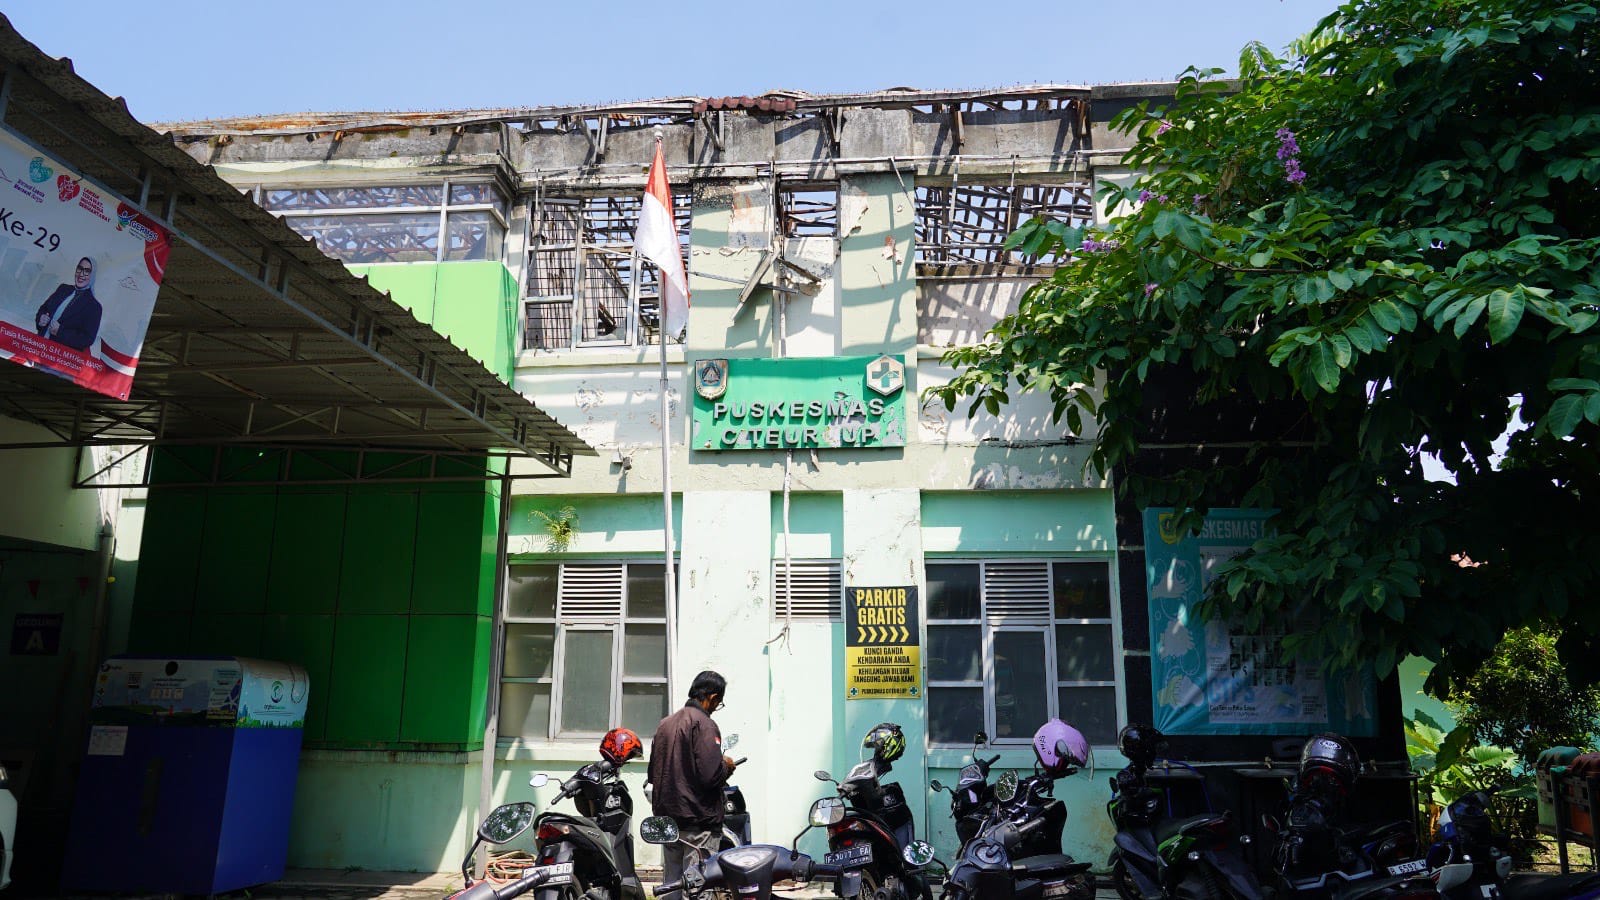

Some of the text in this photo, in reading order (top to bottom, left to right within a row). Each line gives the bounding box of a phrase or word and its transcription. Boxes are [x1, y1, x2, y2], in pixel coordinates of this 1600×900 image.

[0, 207, 61, 252] Ke-29
[131, 221, 159, 241] GERMAS
[41, 351, 56, 362] Dinas
[714, 398, 884, 419] PUSKESMAS
[856, 588, 907, 607] PARKIR
[858, 607, 906, 625] GRATIS
[25, 630, 45, 651] A
[857, 655, 911, 664] KENDARAAN ANDA
[864, 646, 904, 655] KUNCI GANDA
[854, 674, 915, 683] TANGGUNG JAWAB KAMI
[891, 667, 910, 675] DILUAR
